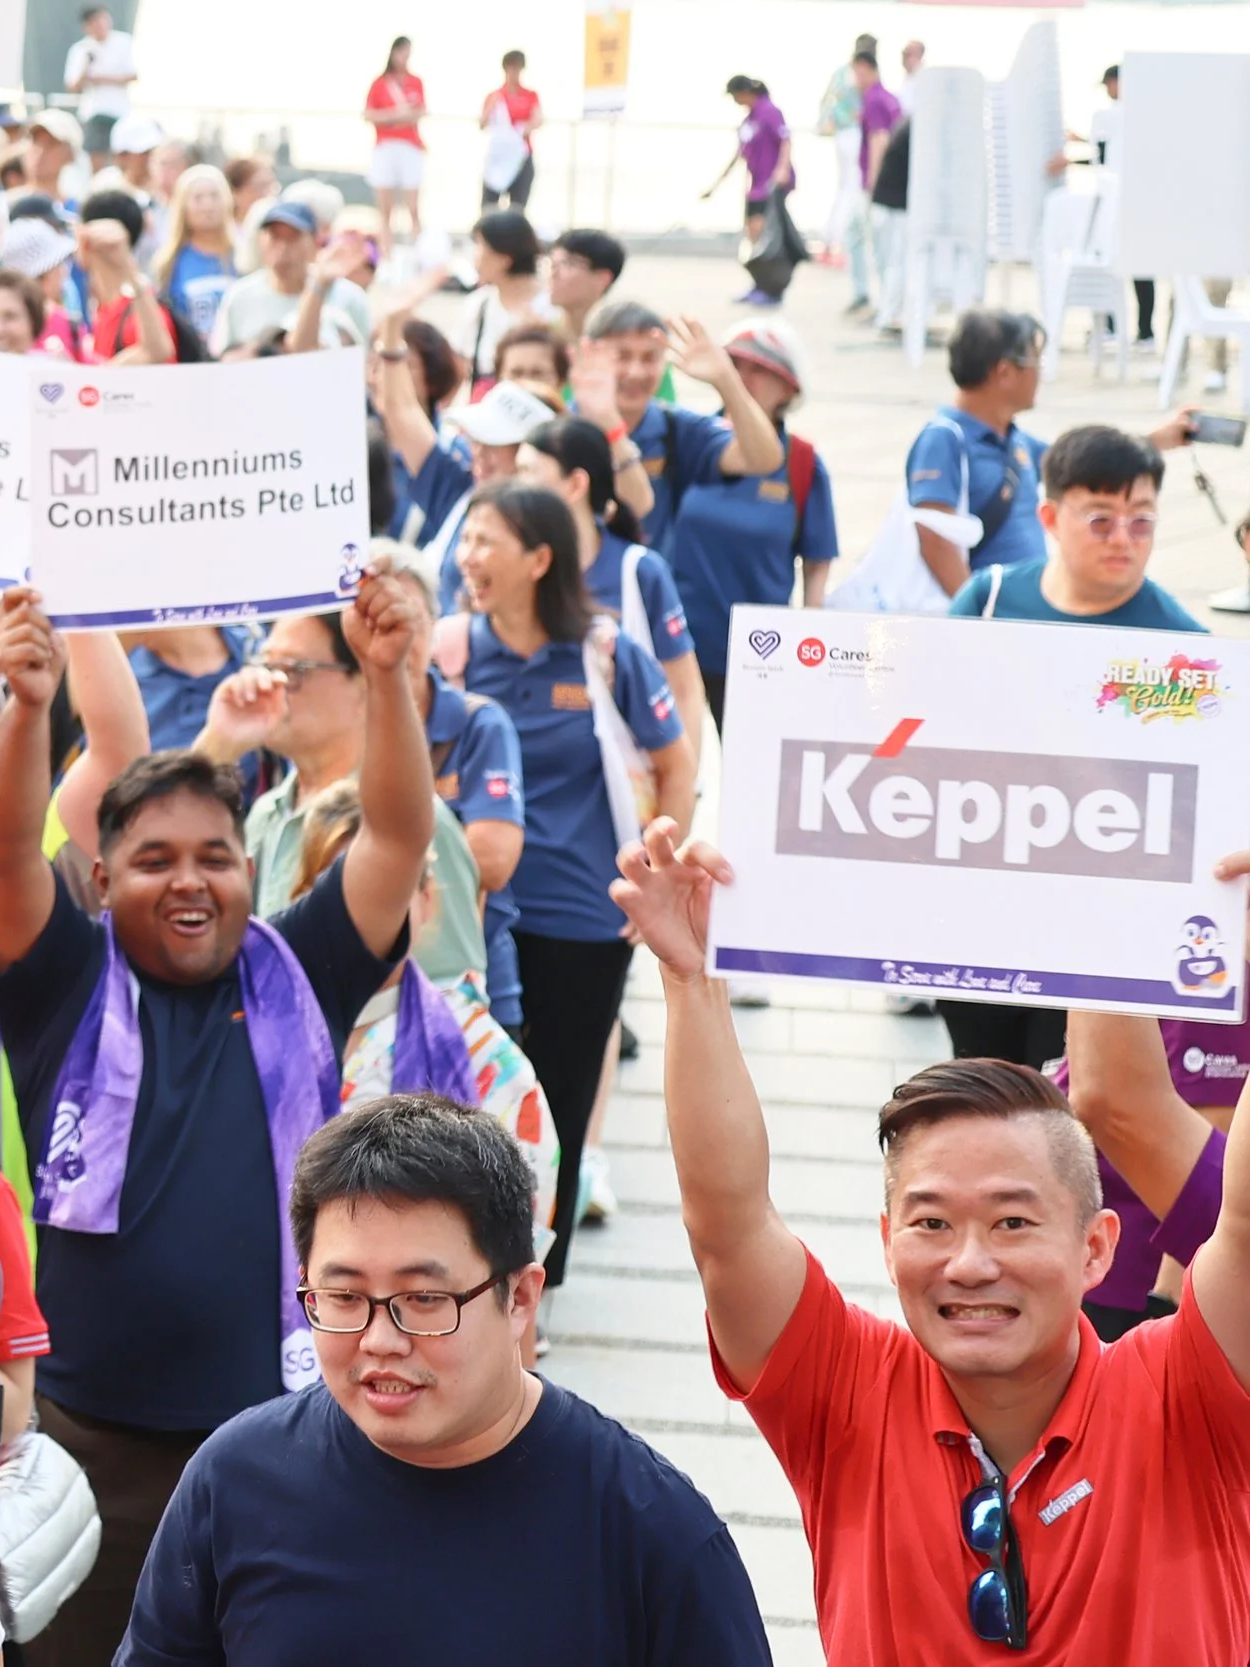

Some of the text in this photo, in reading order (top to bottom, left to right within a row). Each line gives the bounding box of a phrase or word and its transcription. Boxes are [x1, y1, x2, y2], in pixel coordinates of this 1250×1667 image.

[114, 449, 303, 482] Millenniums
[47, 479, 355, 528] Consultants Pte Ltd
[801, 645, 873, 662] SG Cares
[1108, 664, 1216, 690] READY SET
[1126, 683, 1195, 715] Gold!
[285, 1347, 316, 1374] SG
[1040, 1479, 1092, 1525] Keppel
